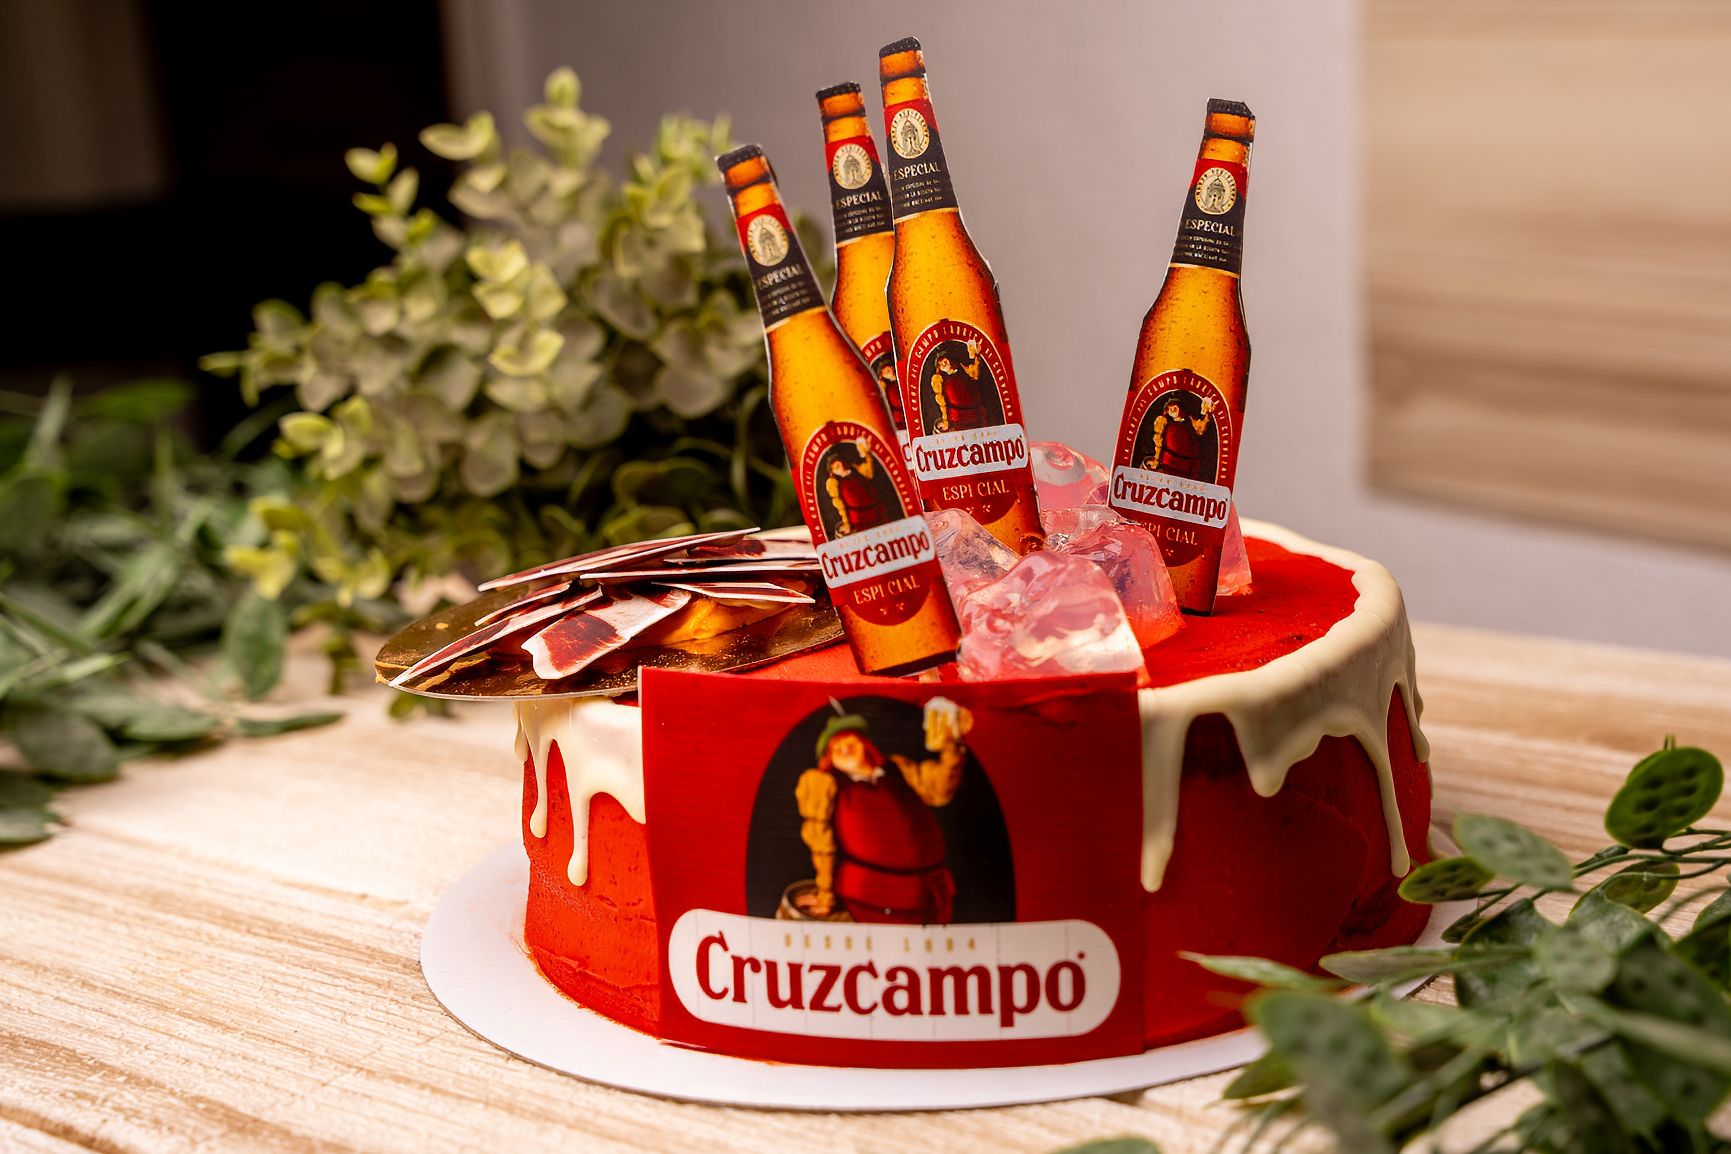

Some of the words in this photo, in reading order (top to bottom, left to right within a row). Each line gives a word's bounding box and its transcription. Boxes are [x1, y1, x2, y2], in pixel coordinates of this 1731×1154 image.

[893, 161, 941, 181] ESPECIAL
[836, 190, 884, 209] ESPECIAL
[1185, 218, 1236, 237] ESPECIAL
[915, 436, 1025, 473] Cruzcampo
[1113, 472, 1228, 523] Cruzcampo
[821, 529, 930, 580] Cruzcampo
[695, 930, 1087, 1029] Cruzcampo
